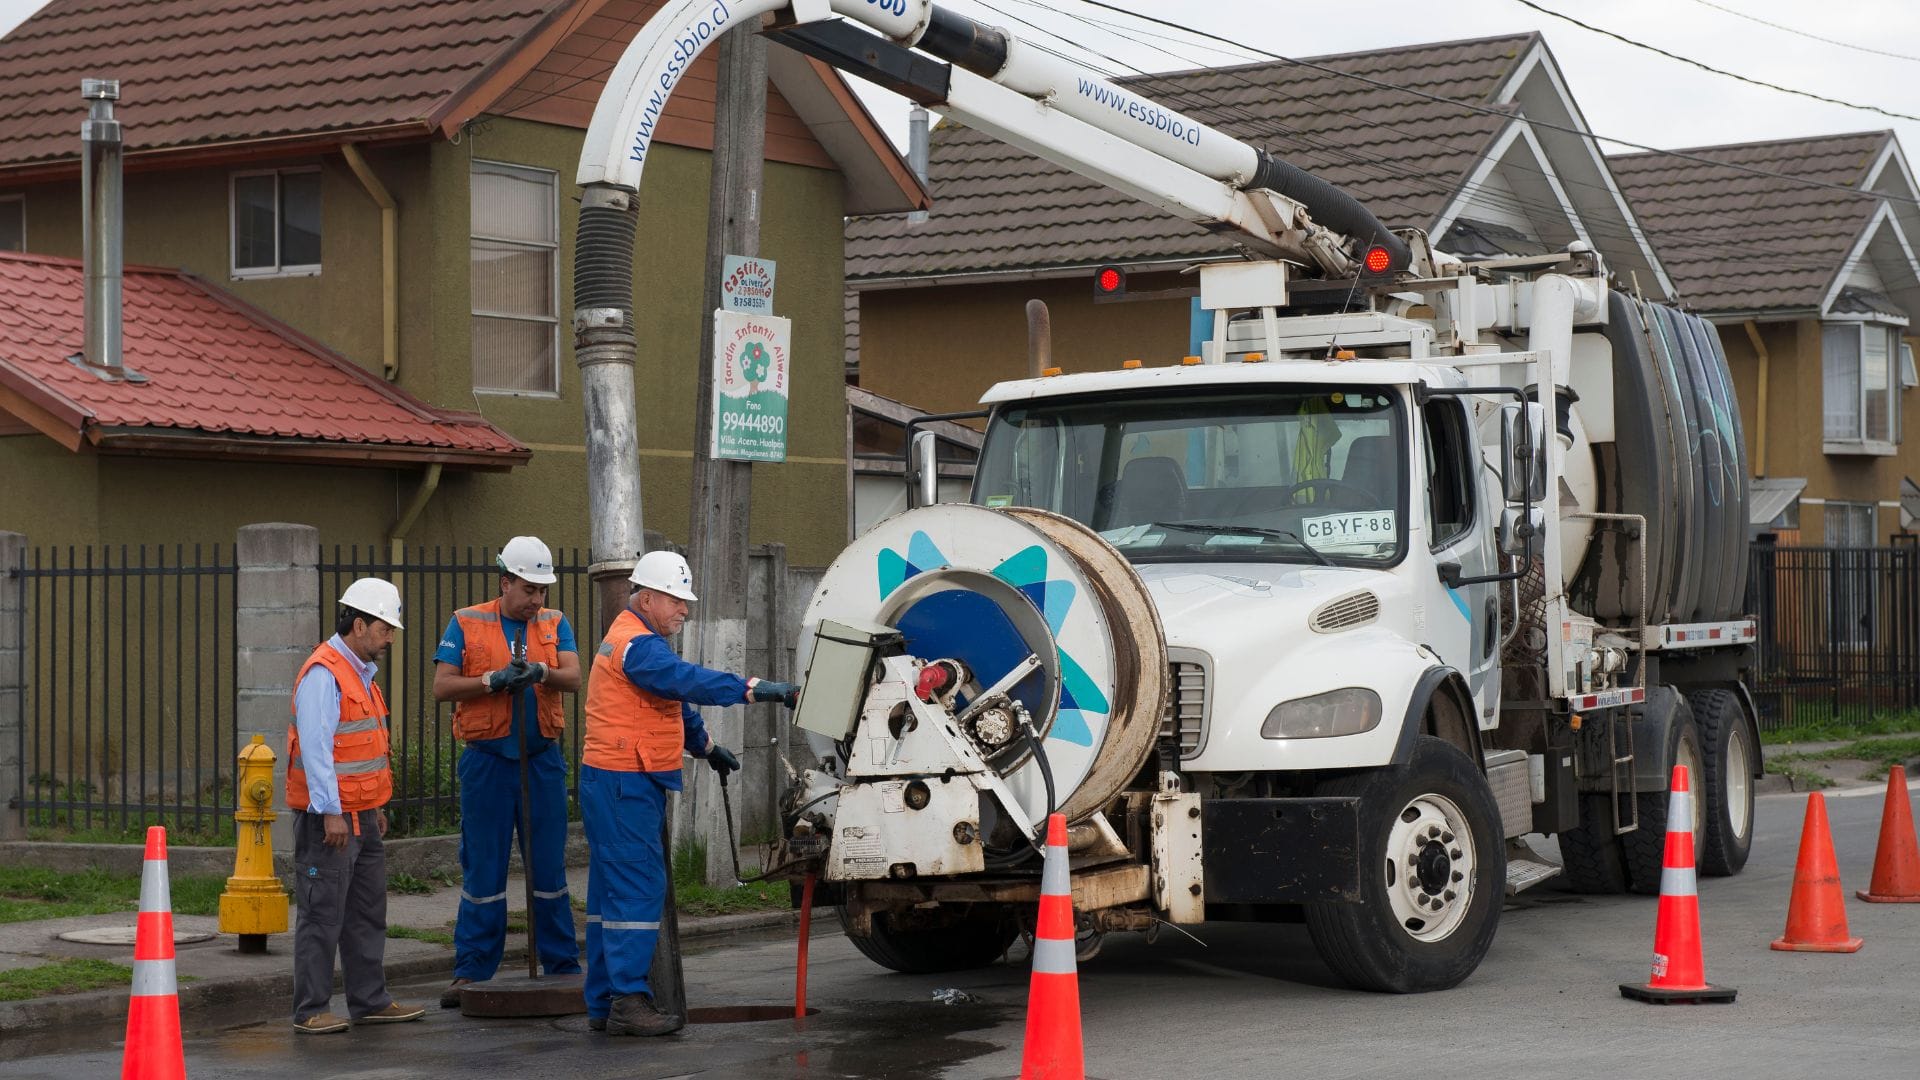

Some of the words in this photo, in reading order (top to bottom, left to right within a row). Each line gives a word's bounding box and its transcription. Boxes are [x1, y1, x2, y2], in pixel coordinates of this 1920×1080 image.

[630, 0, 730, 162] www.essbio.cl
[1078, 77, 1200, 146] www.essbio.cl
[735, 322, 775, 341] Infantil
[774, 346, 785, 388] Aliwen
[723, 411, 784, 434] 99444890
[746, 400, 762, 411] Fono
[720, 435, 736, 445] Villa
